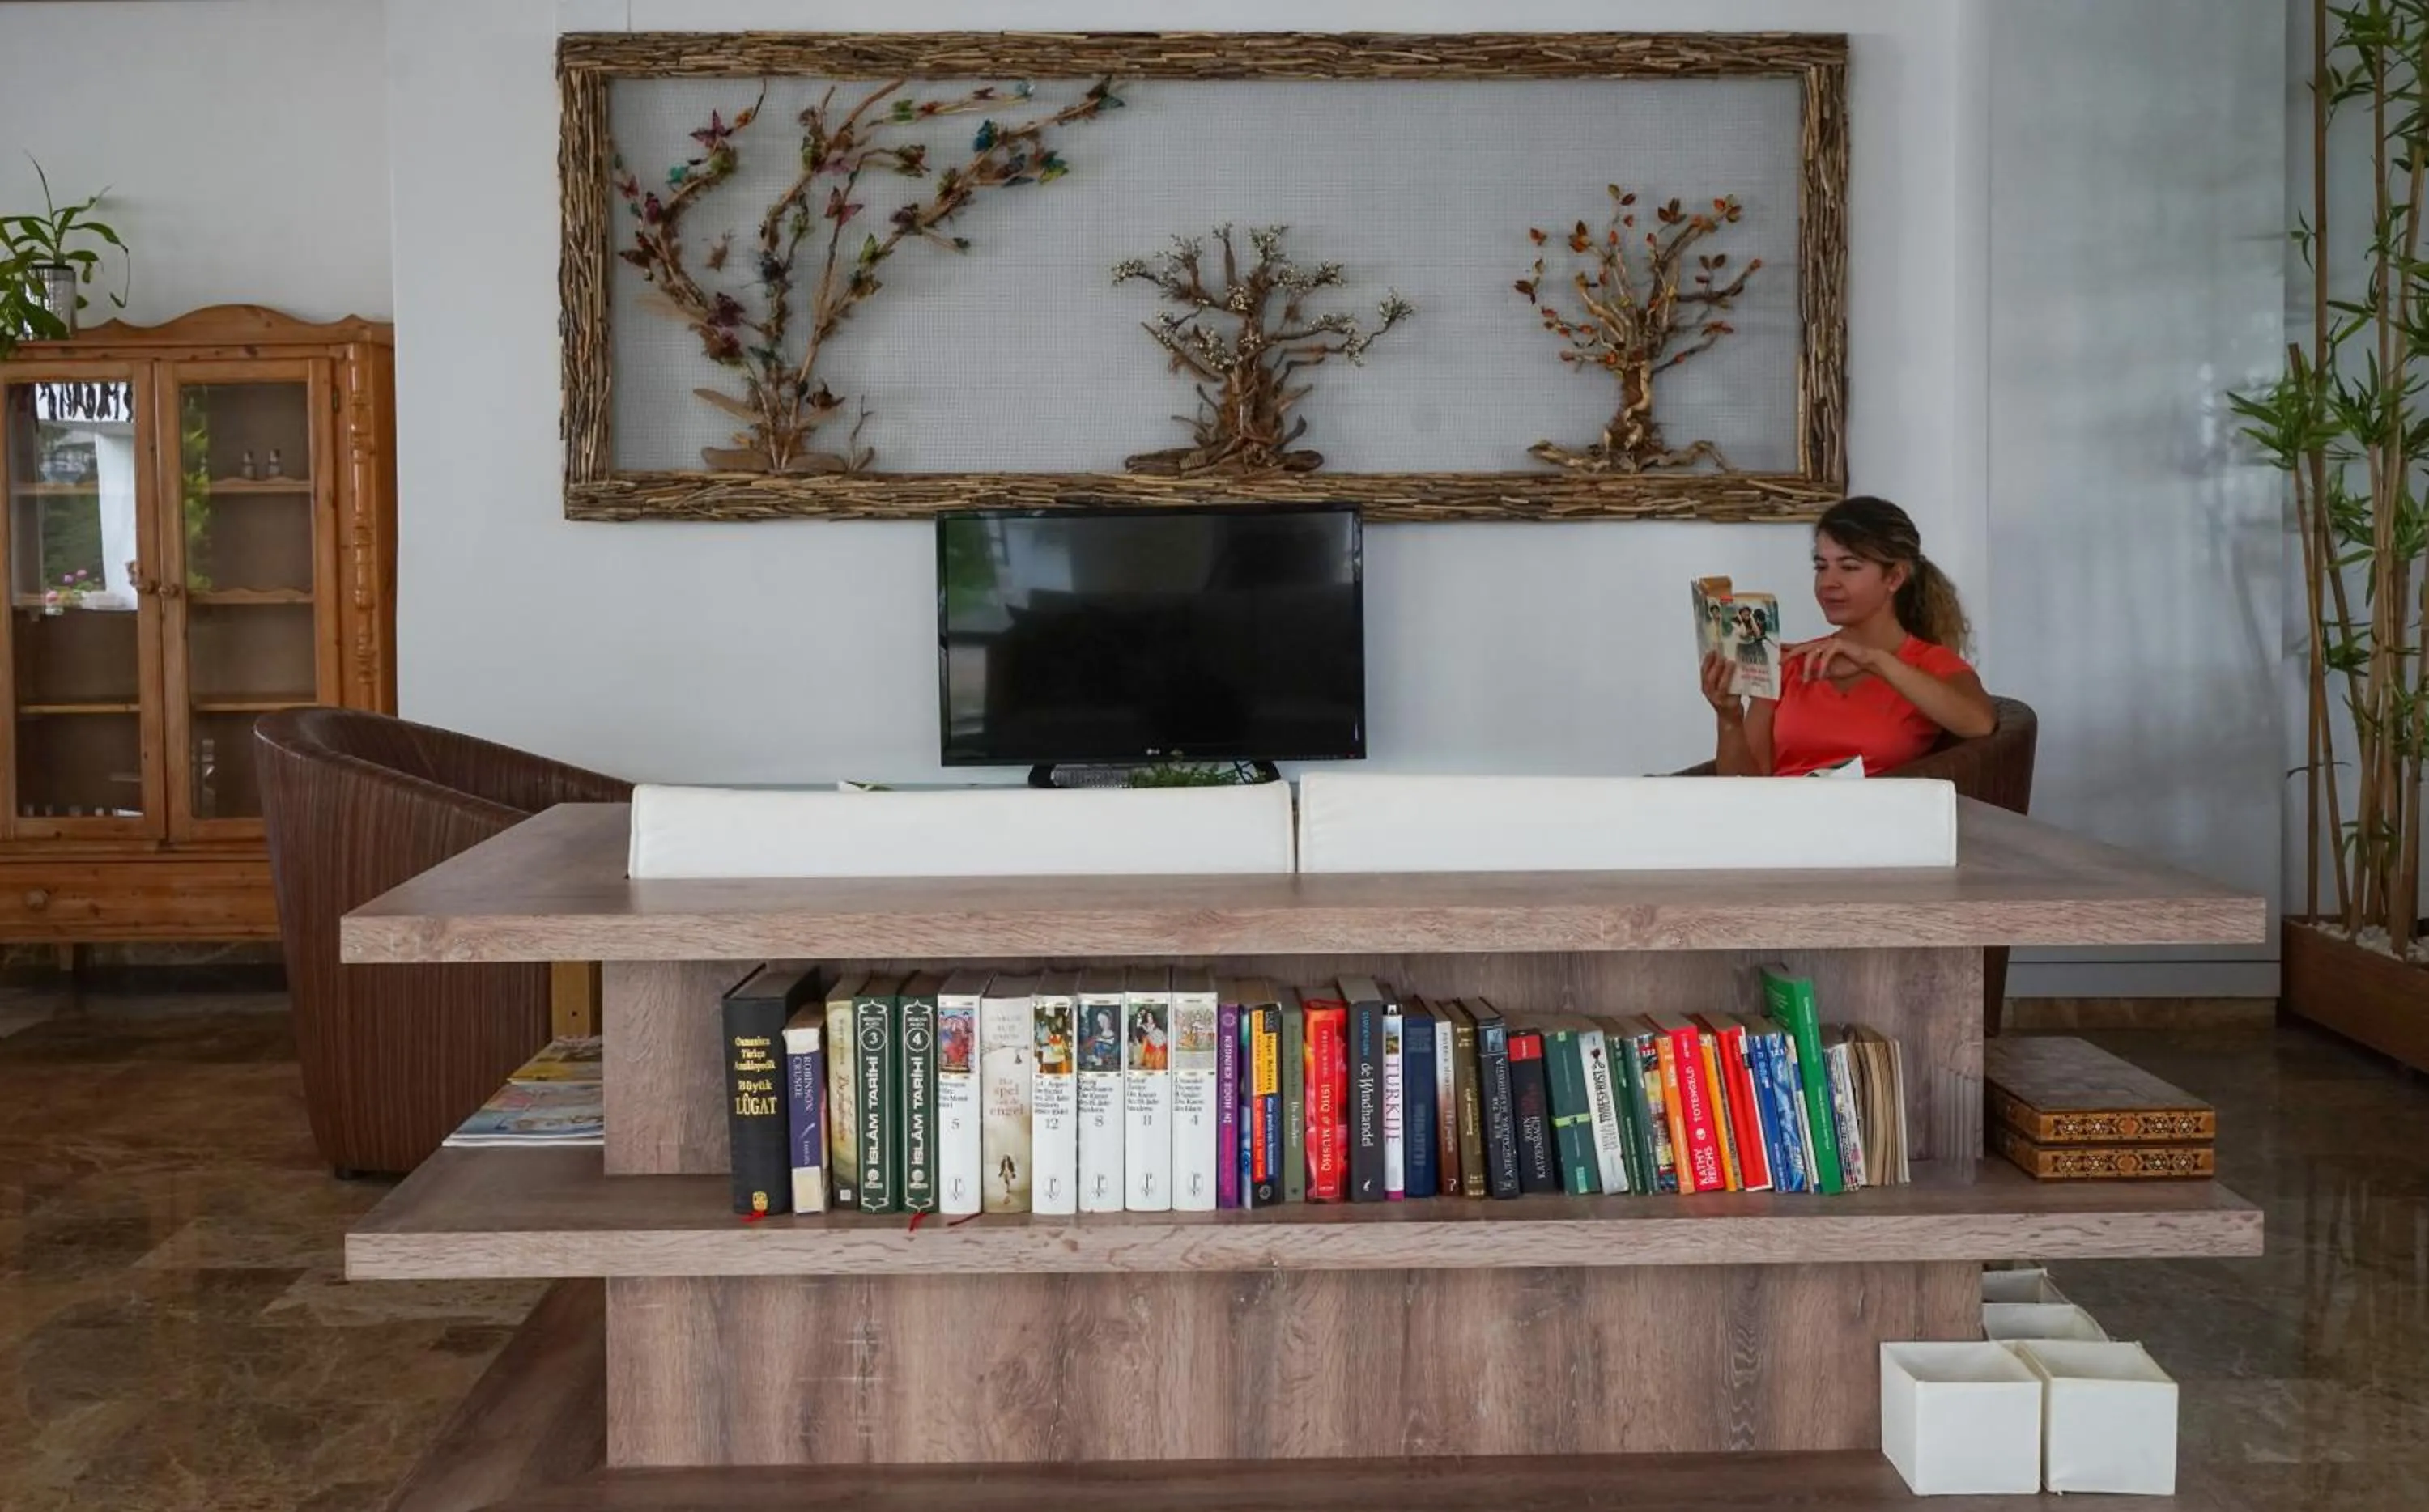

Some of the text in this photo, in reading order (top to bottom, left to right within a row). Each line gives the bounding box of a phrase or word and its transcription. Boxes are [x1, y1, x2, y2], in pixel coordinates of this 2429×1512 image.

[869, 1032, 878, 1045] 3
[912, 1032, 922, 1045] 4
[738, 1079, 772, 1093] Büyük
[793, 1055, 802, 1098] CRUSOE
[803, 1055, 814, 1113] ROBINSON
[866, 1055, 878, 1110] TARİHİ
[912, 1055, 924, 1110] TARİHİ
[1361, 1062, 1373, 1077] de
[1321, 1084, 1332, 1112] ISHQ
[1685, 1066, 1704, 1123] TOTENGELD
[1044, 1118, 1059, 1129] 12
[1094, 1115, 1104, 1127] 8
[1321, 1128, 1332, 1171] MUSHQ
[1530, 1115, 1546, 1179] KATZENBACH
[1703, 1145, 1718, 1183] REICHS
[1694, 1148, 1709, 1185] KATHY
